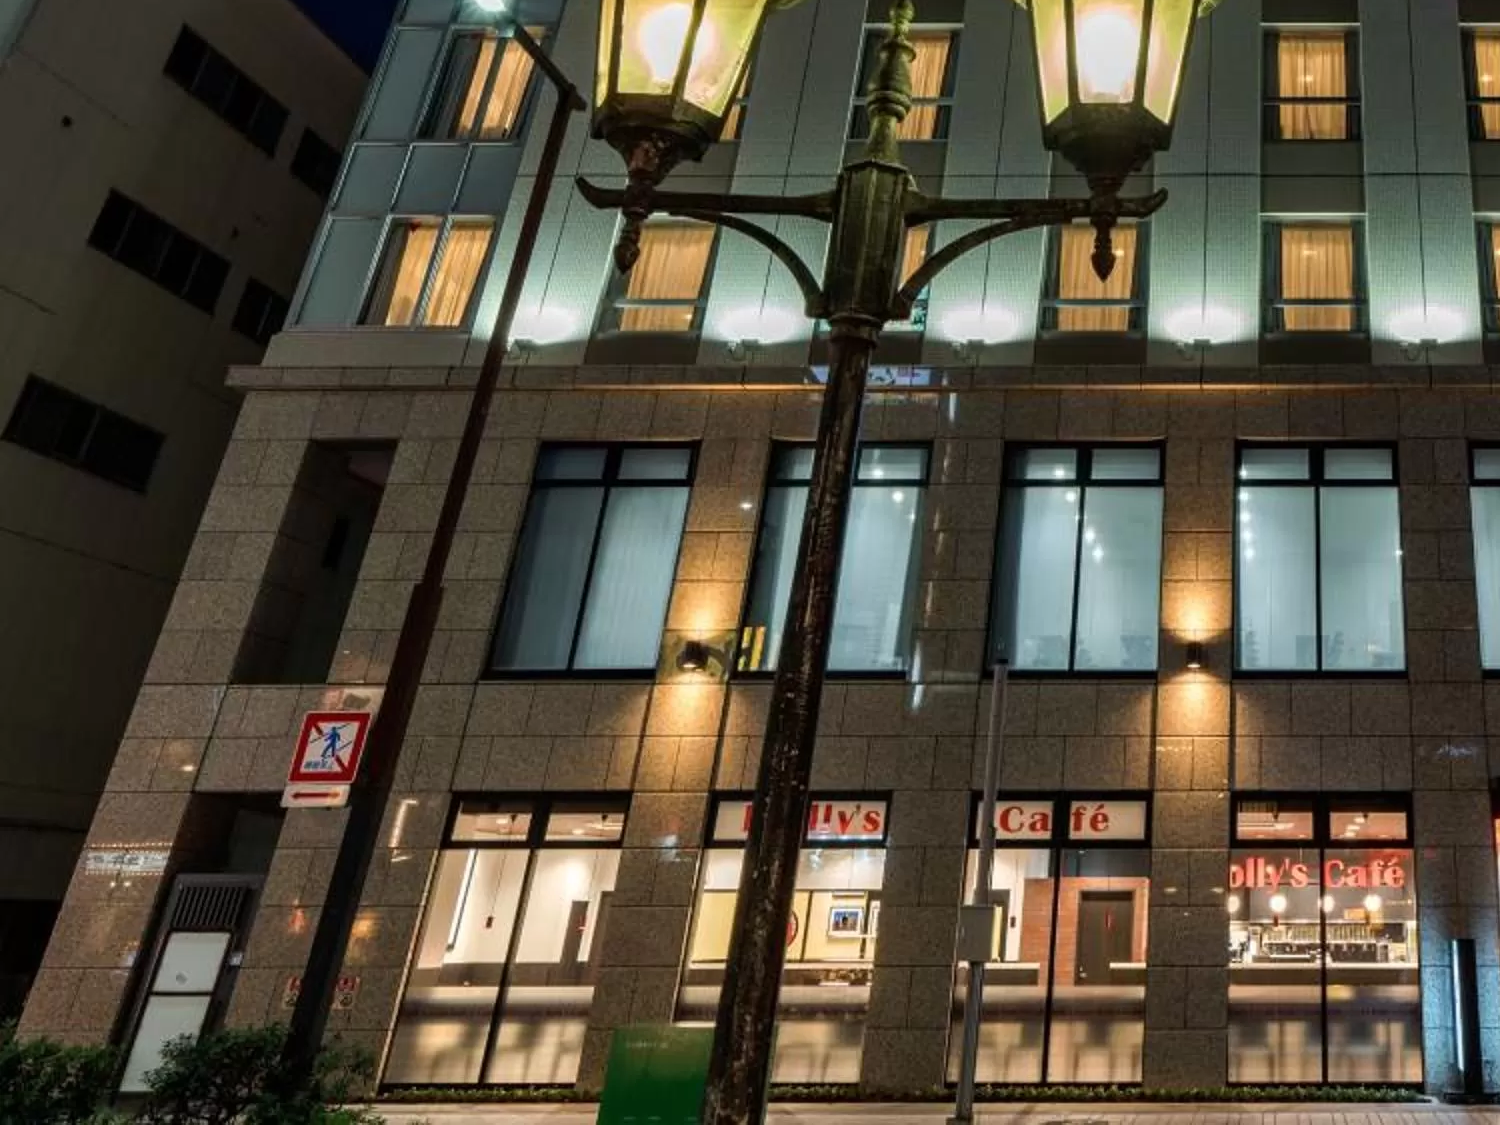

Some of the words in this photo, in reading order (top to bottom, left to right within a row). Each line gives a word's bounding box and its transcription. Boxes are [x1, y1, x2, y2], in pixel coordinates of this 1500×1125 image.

[742, 803, 881, 835] lly's
[1000, 804, 1109, 833] Café
[1230, 857, 1309, 893] olly's
[1324, 857, 1406, 889] Café
